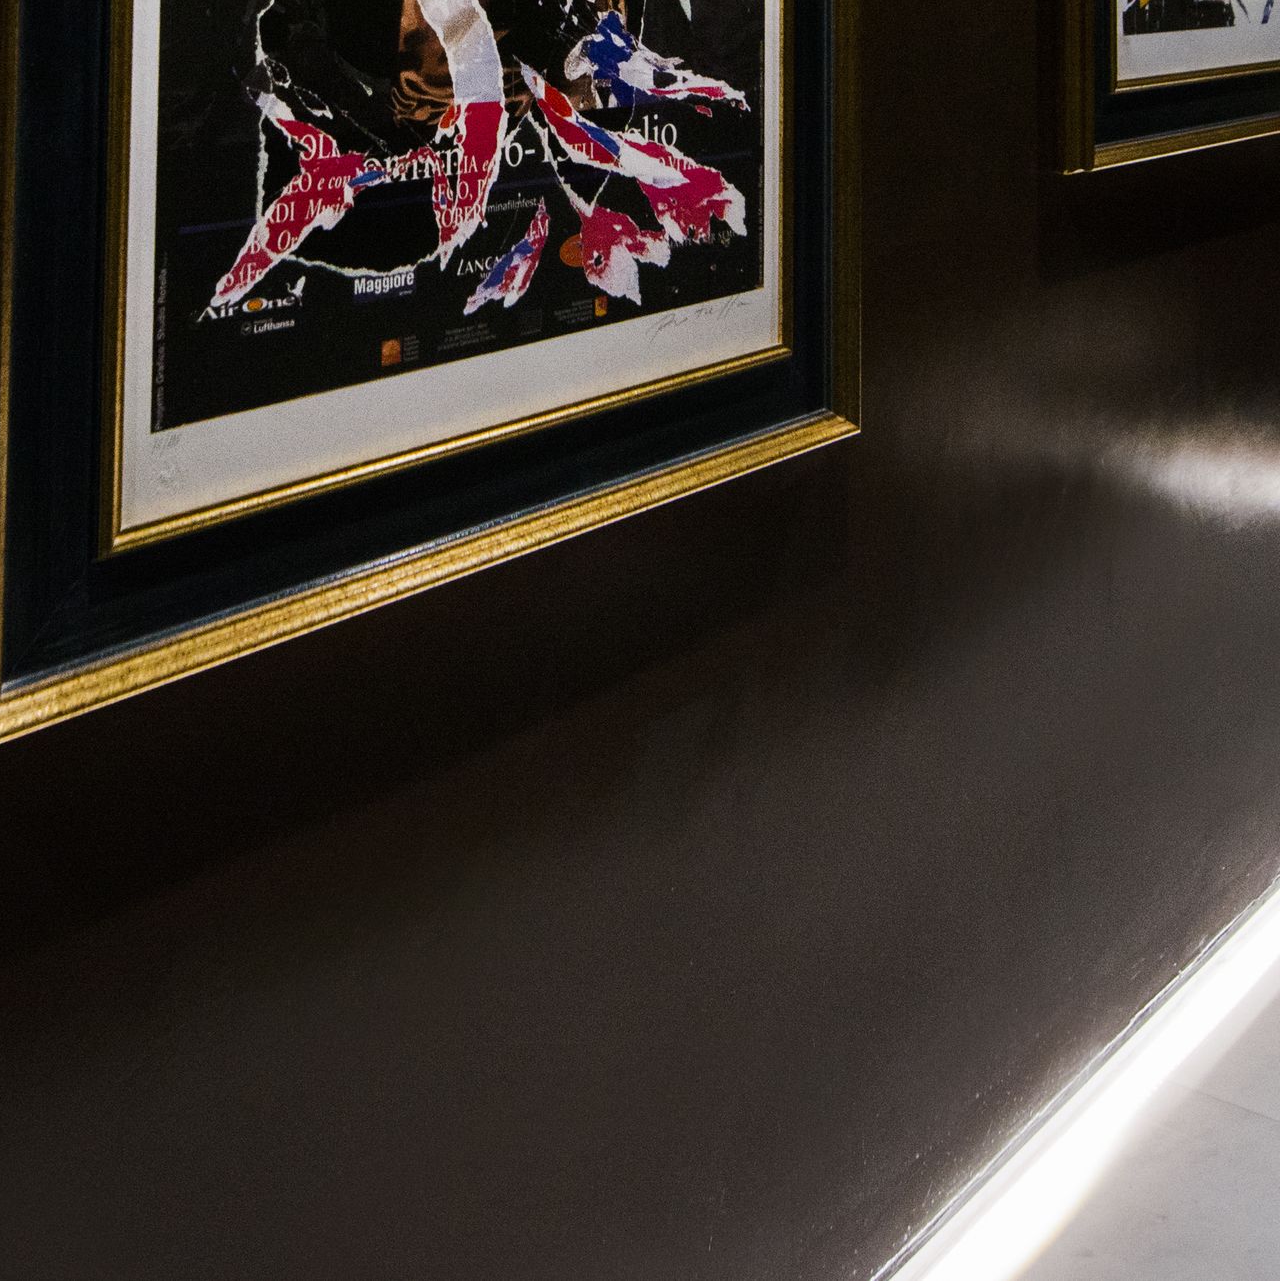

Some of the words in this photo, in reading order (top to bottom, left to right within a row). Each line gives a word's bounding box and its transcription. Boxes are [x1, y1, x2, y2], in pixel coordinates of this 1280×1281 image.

[354, 271, 415, 296] Maggiore
[242, 295, 296, 315] One
[253, 320, 296, 335] Lufthansa
